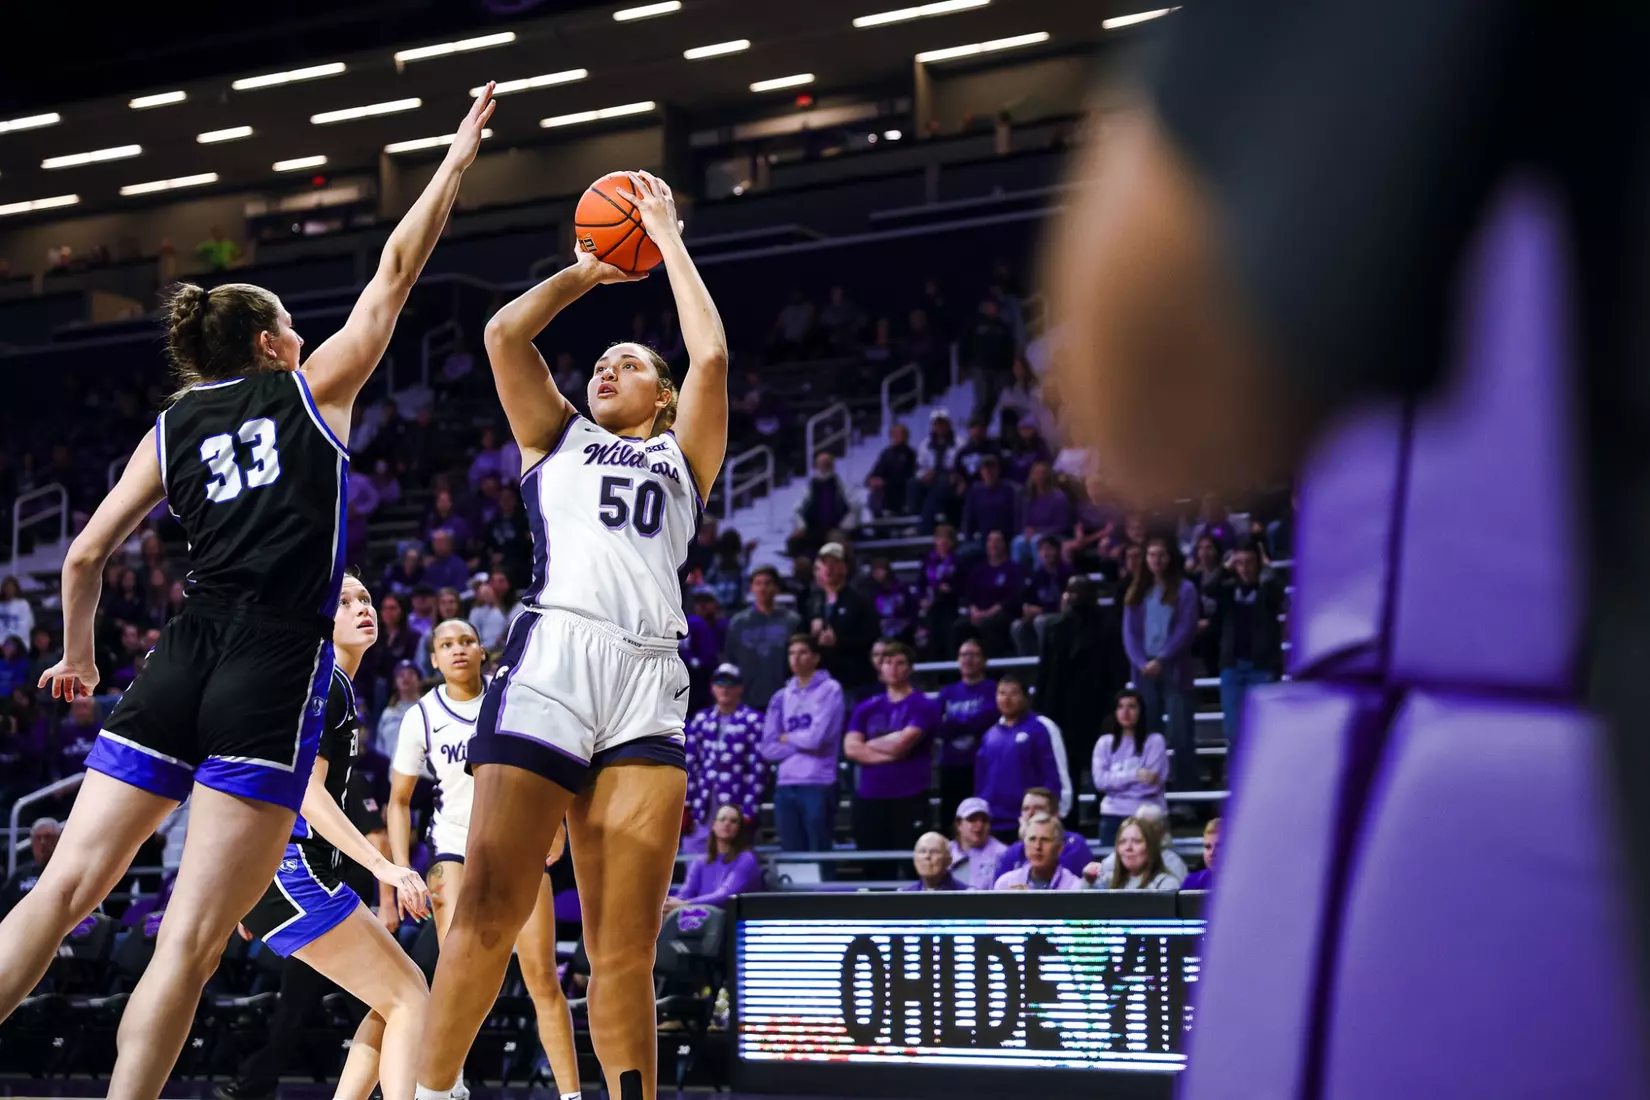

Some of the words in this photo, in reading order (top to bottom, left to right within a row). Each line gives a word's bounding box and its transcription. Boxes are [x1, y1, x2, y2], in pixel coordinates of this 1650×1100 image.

[199, 417, 281, 503] 33
[583, 440, 680, 484] Wildats
[599, 475, 665, 538] 50
